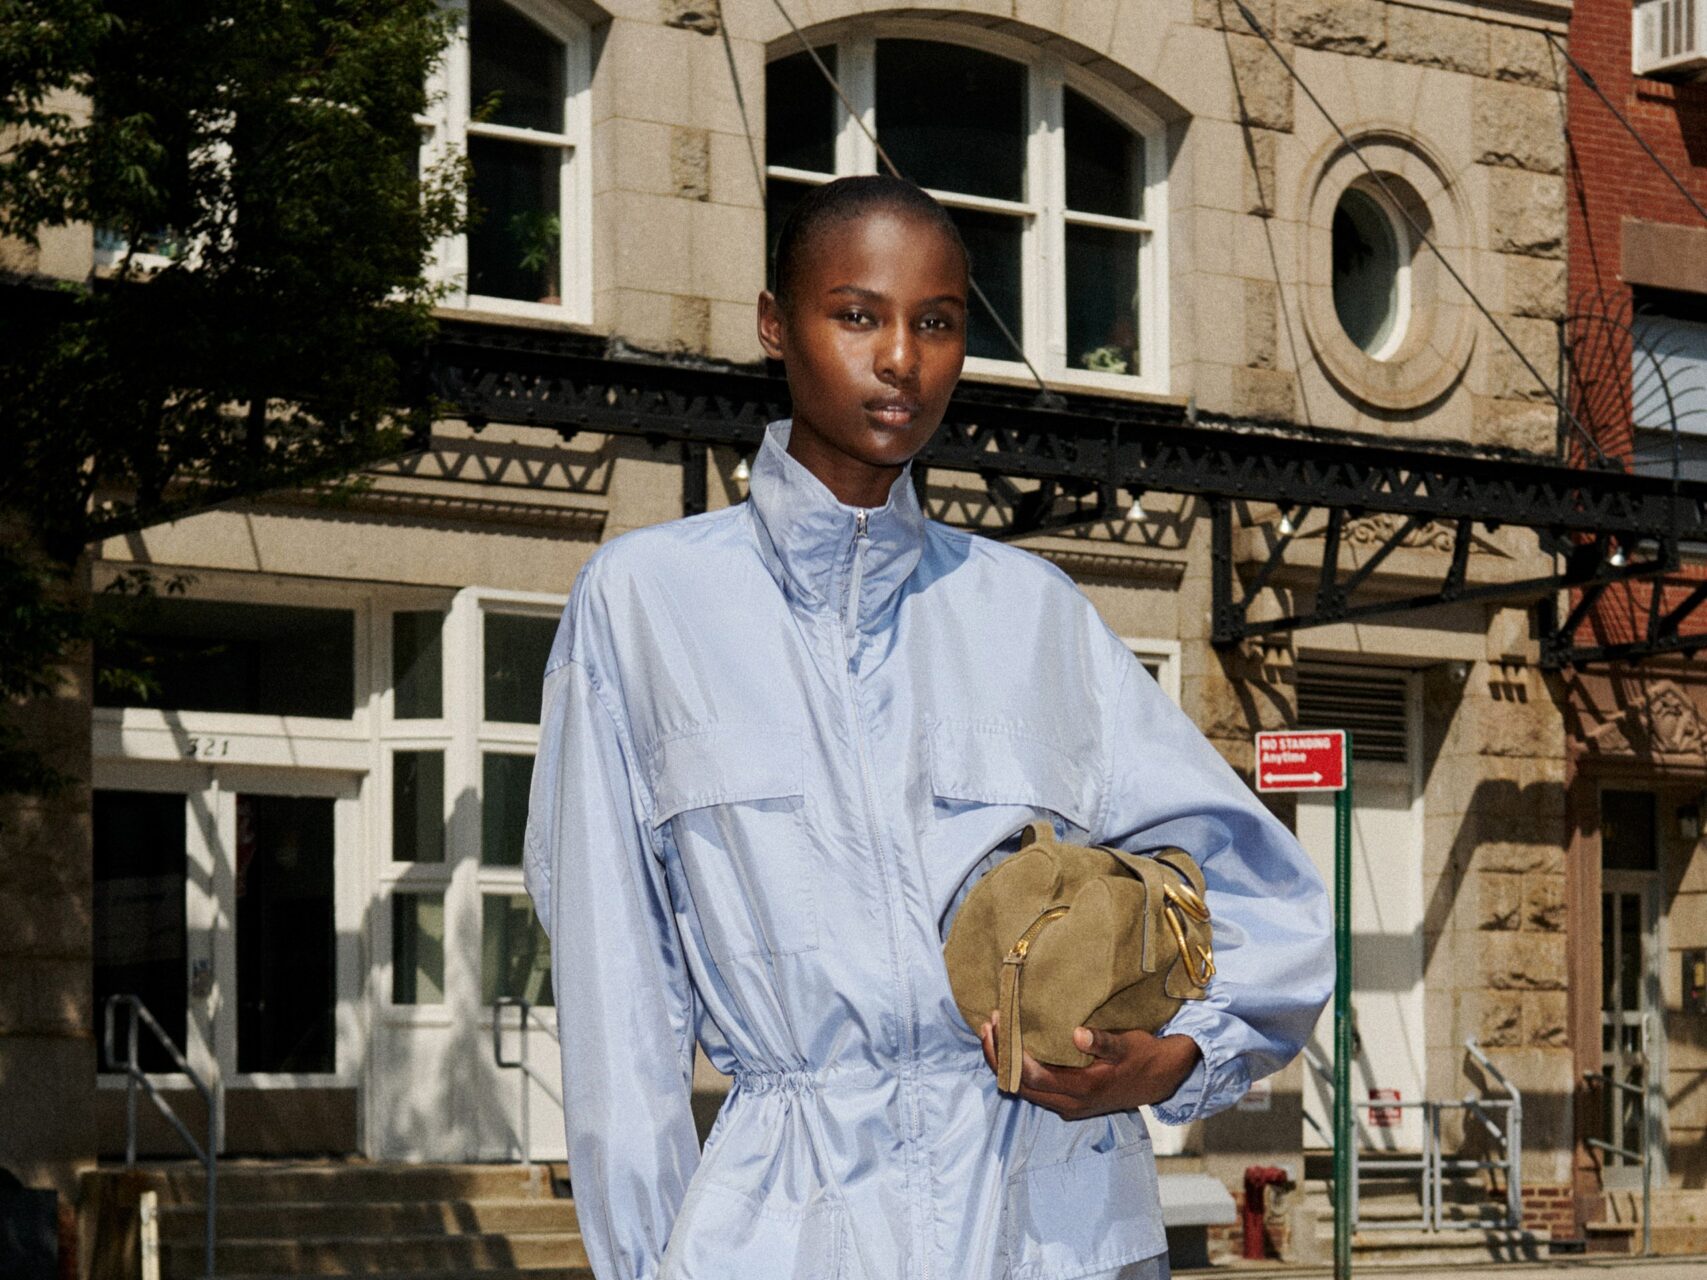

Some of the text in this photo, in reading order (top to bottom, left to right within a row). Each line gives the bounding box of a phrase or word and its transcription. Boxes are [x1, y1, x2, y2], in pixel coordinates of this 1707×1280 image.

[187, 738, 229, 756] 321
[1261, 738, 1331, 750] NO STANDING
[1262, 752, 1307, 764] Anytime
